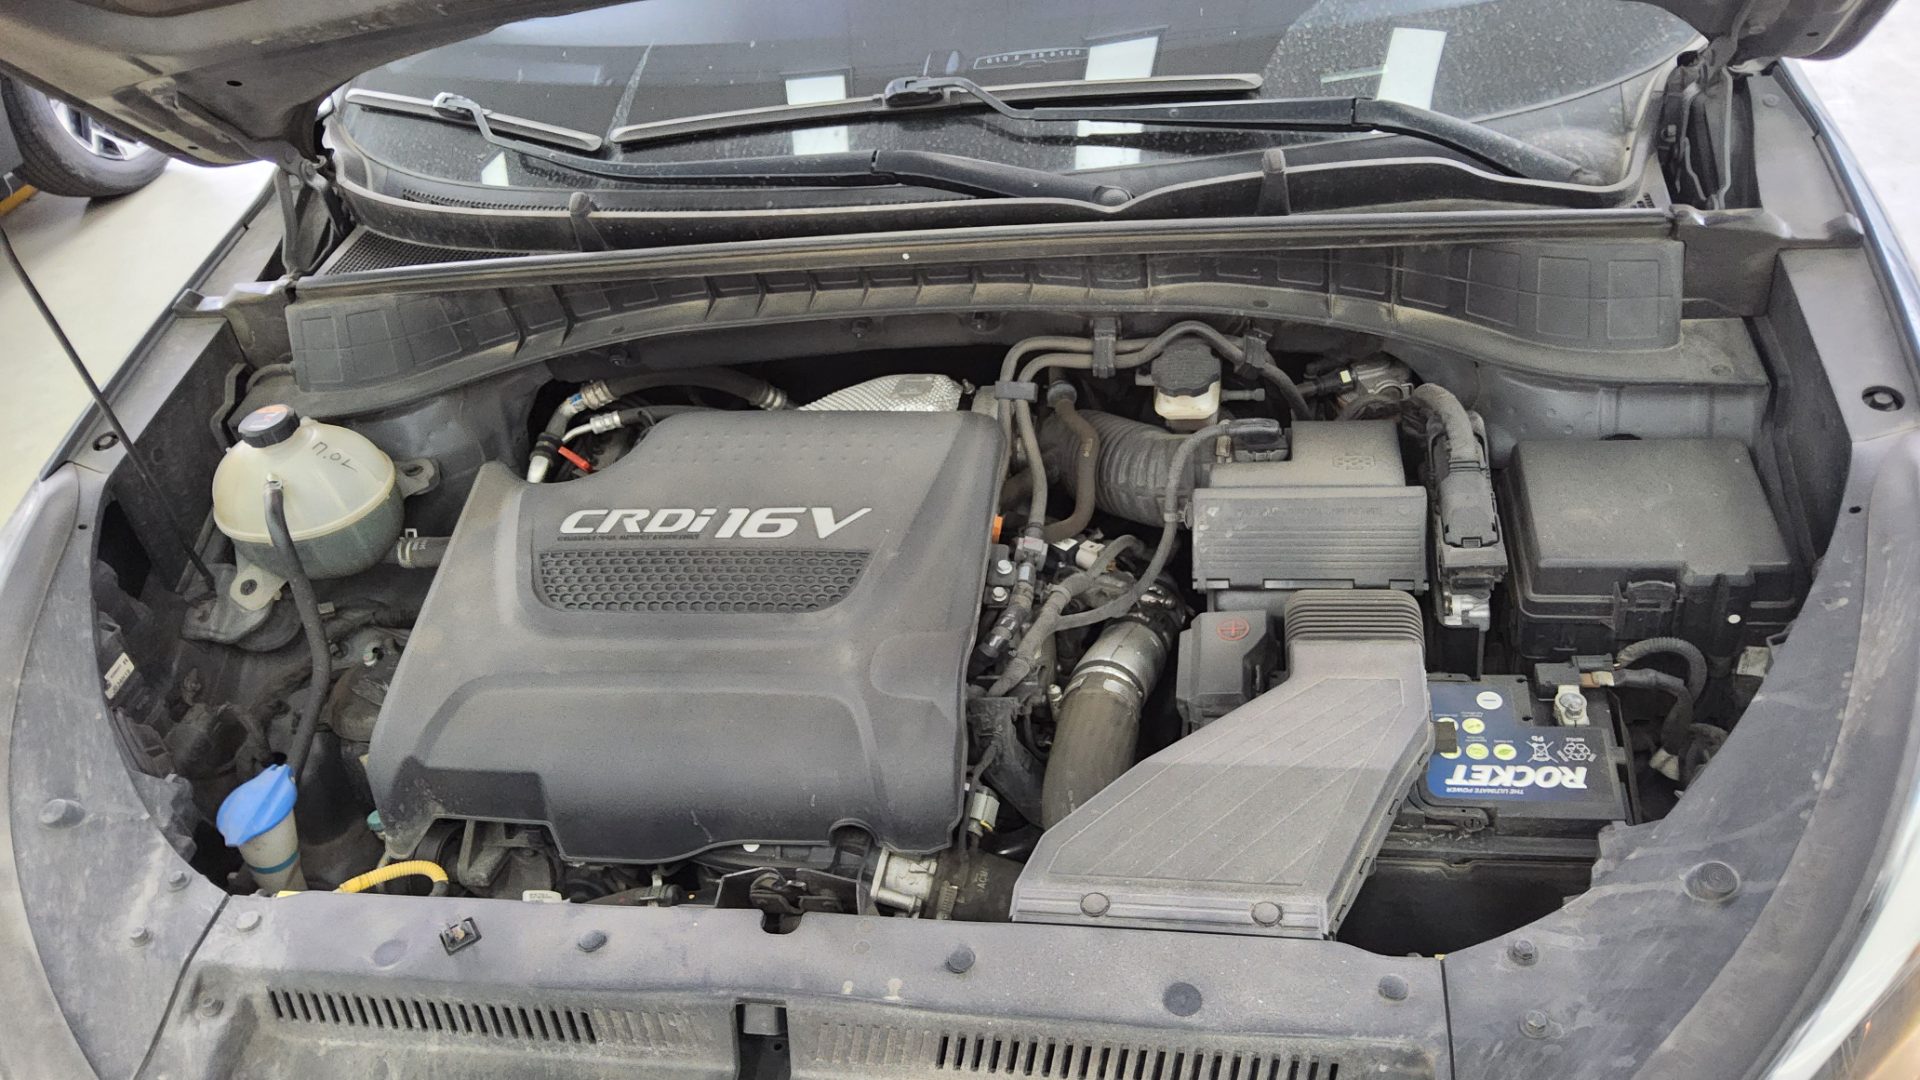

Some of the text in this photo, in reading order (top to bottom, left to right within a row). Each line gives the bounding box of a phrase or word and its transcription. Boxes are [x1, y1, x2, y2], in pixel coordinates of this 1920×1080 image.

[559, 507, 873, 539] CRDi 16V
[1445, 764, 1588, 789] ROCKET
